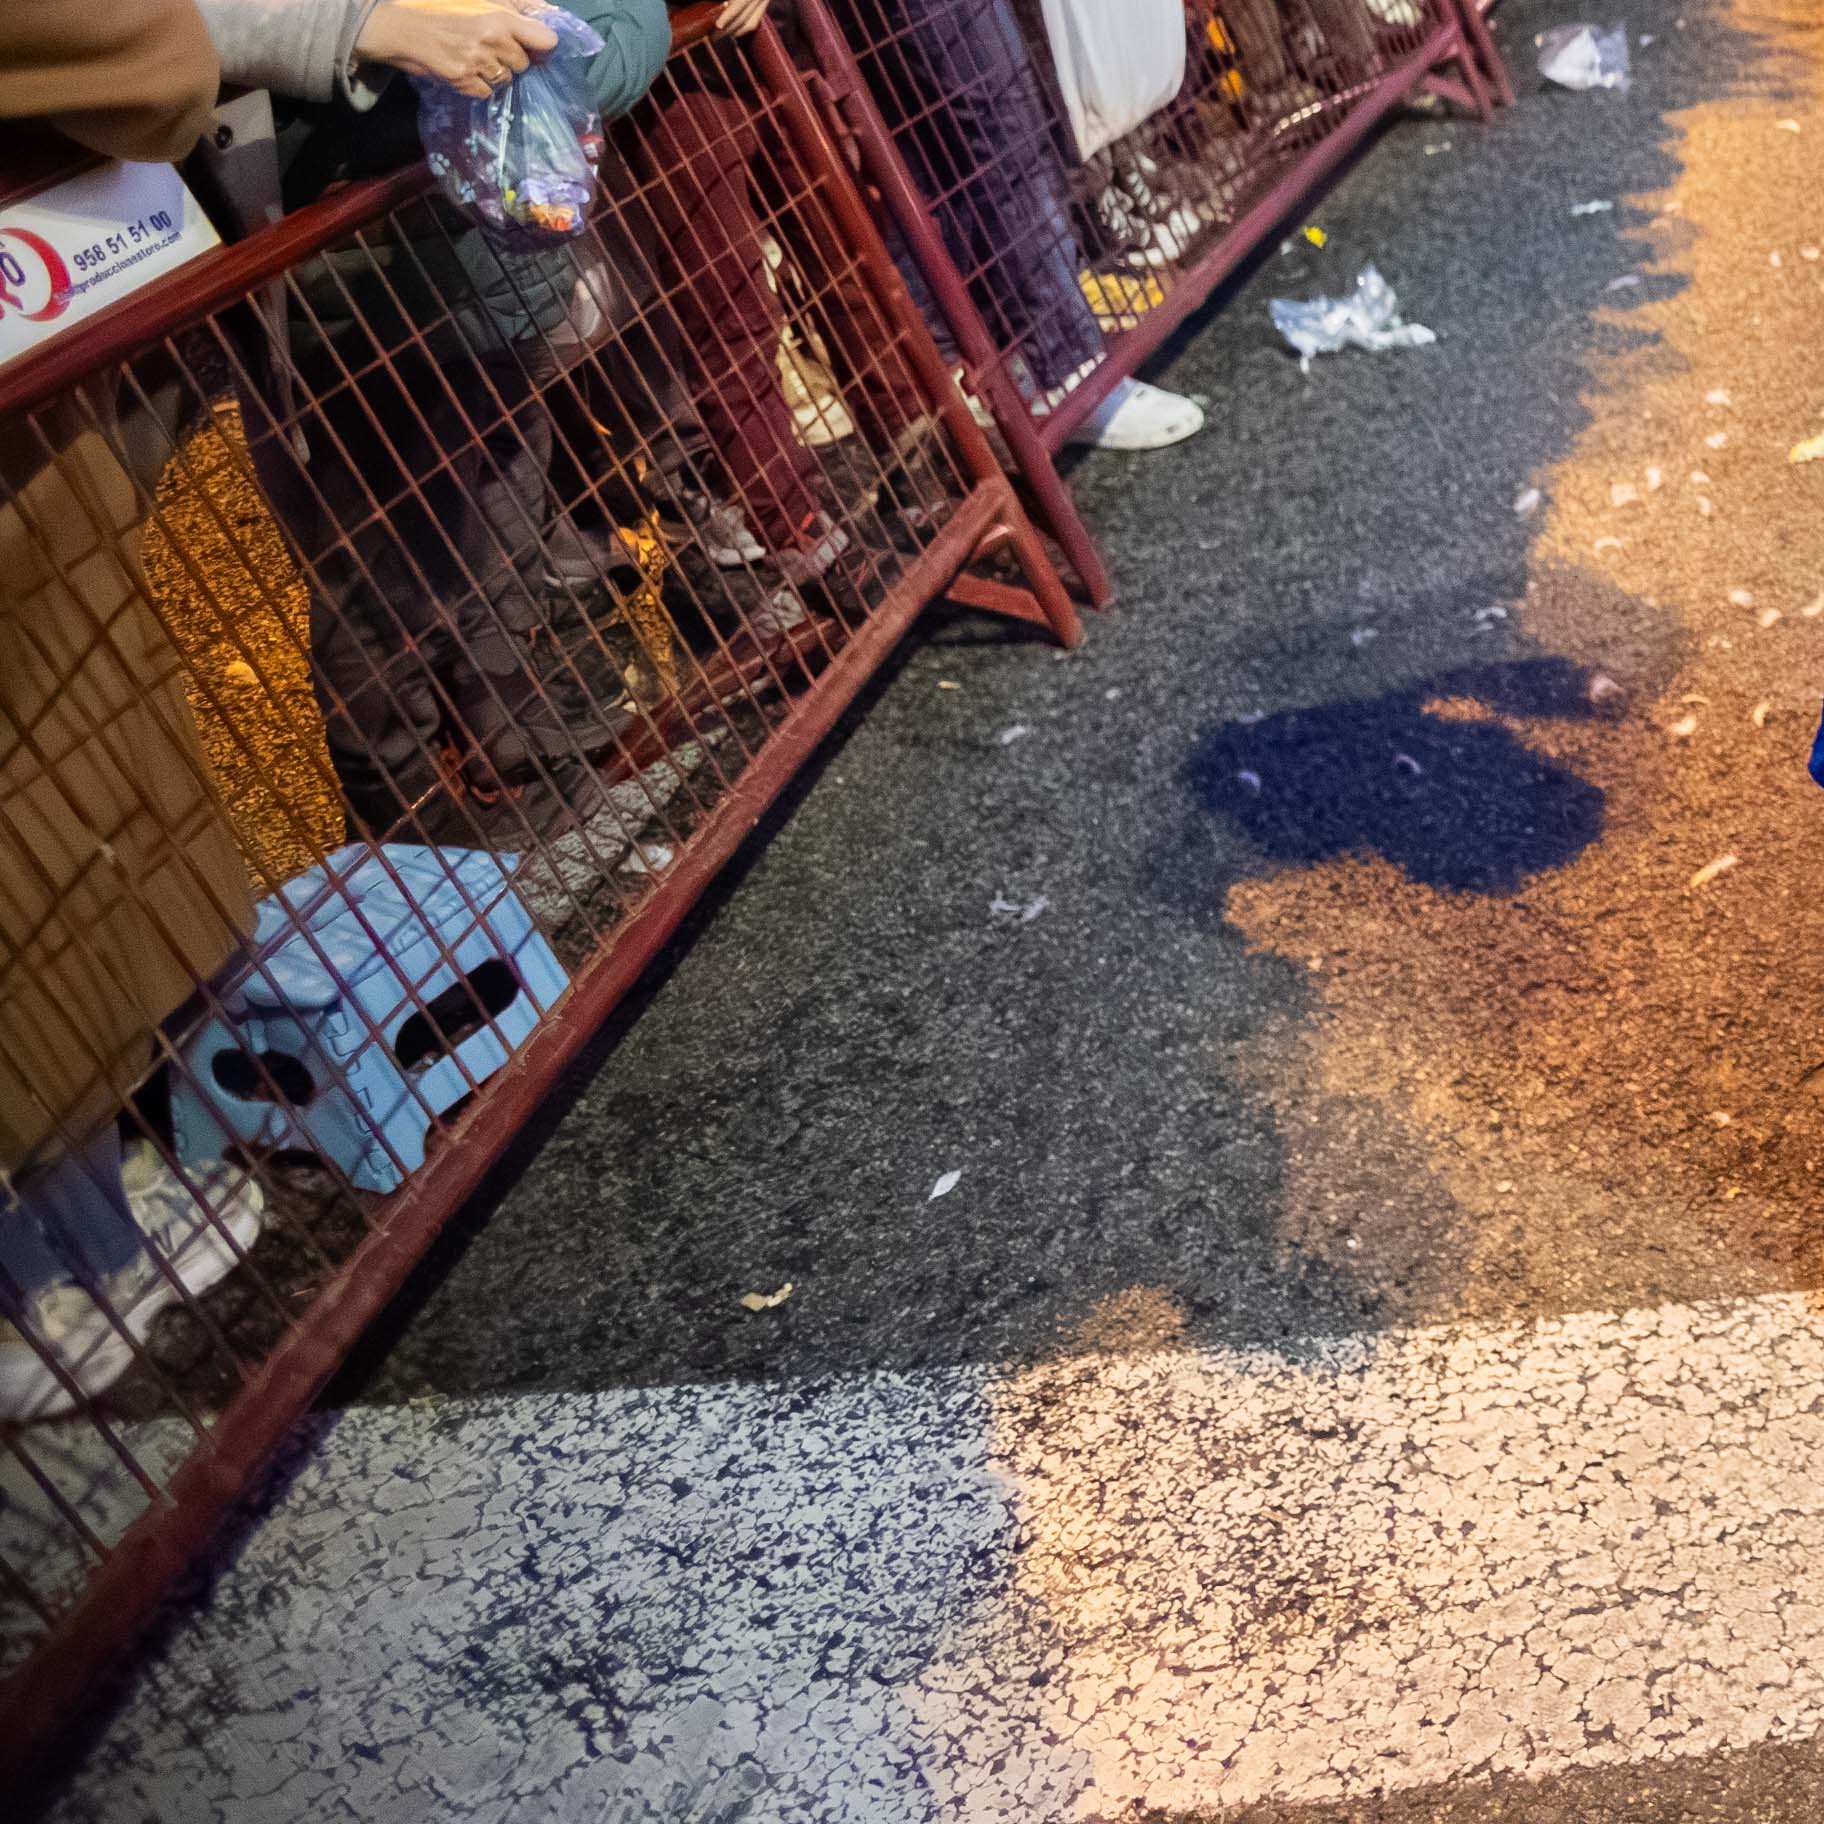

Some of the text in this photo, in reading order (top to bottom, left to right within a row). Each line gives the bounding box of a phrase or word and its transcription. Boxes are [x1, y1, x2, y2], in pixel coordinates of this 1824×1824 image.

[73, 210, 173, 272] 958 51 51 00
